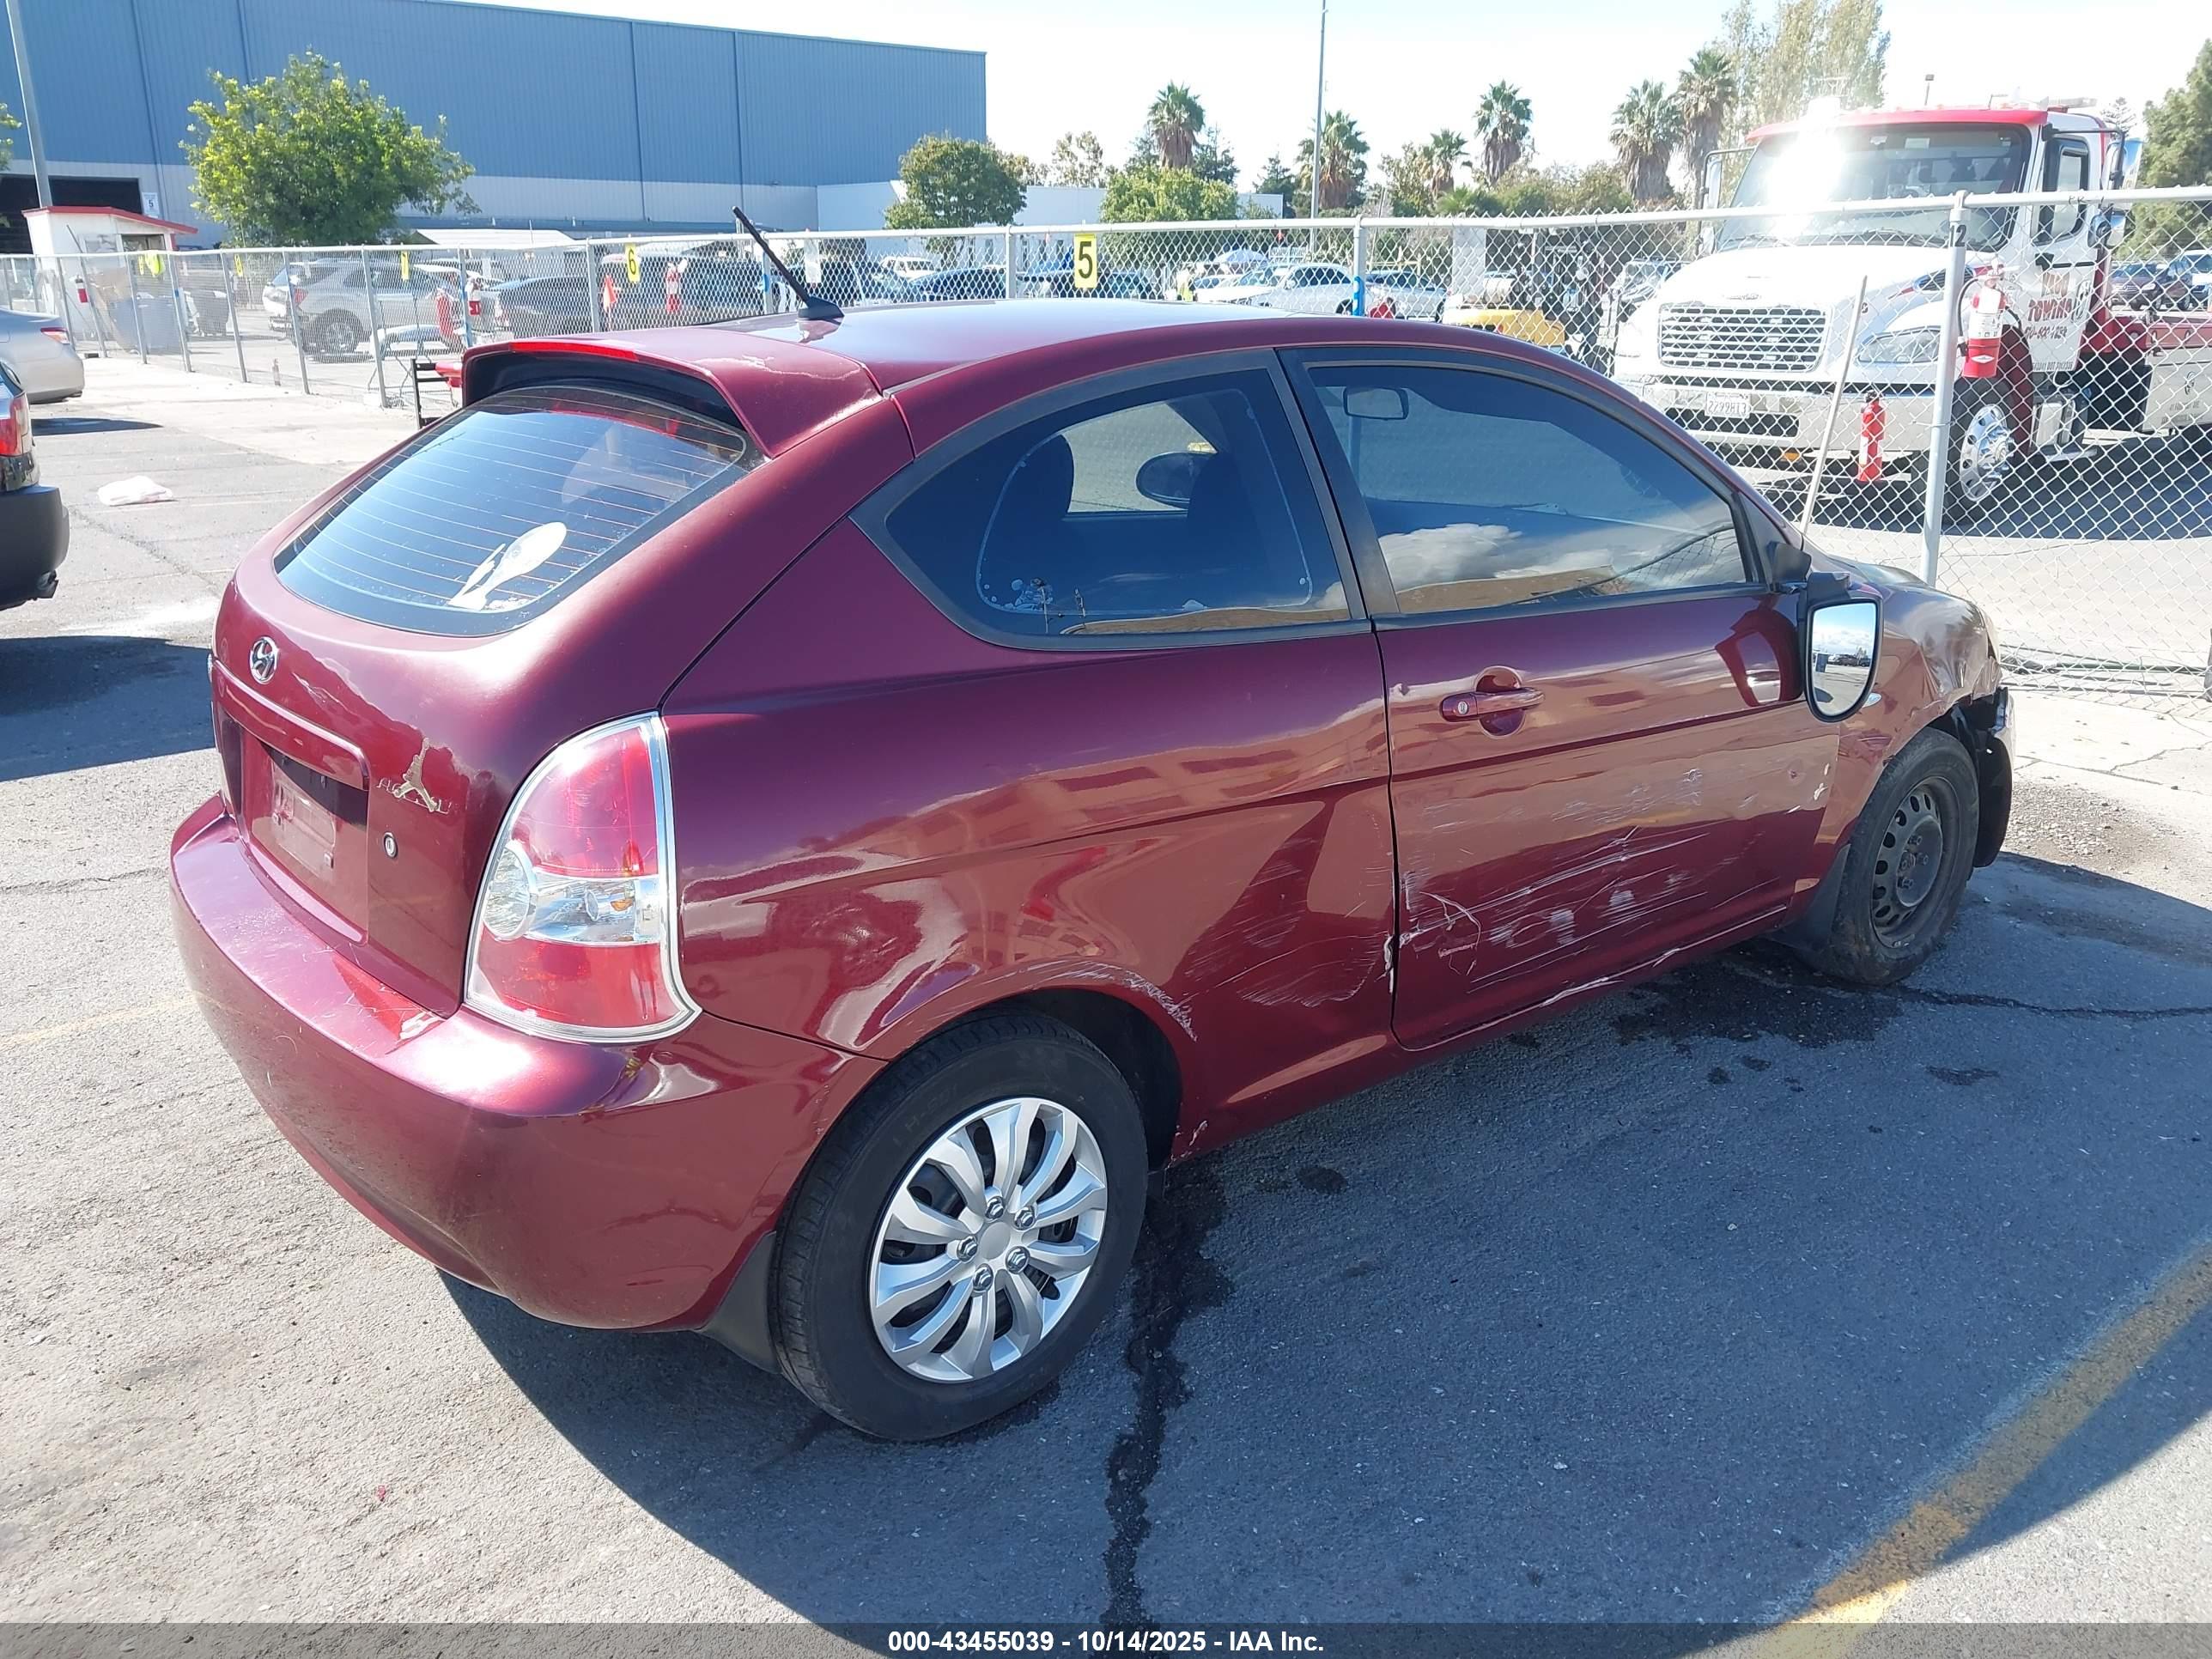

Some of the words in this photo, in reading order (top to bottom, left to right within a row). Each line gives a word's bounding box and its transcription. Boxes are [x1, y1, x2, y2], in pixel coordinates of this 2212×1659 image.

[148, 199, 154, 208] 5
[1948, 223, 1967, 248] 12
[629, 249, 636, 275] 6
[1079, 240, 1093, 279] 5
